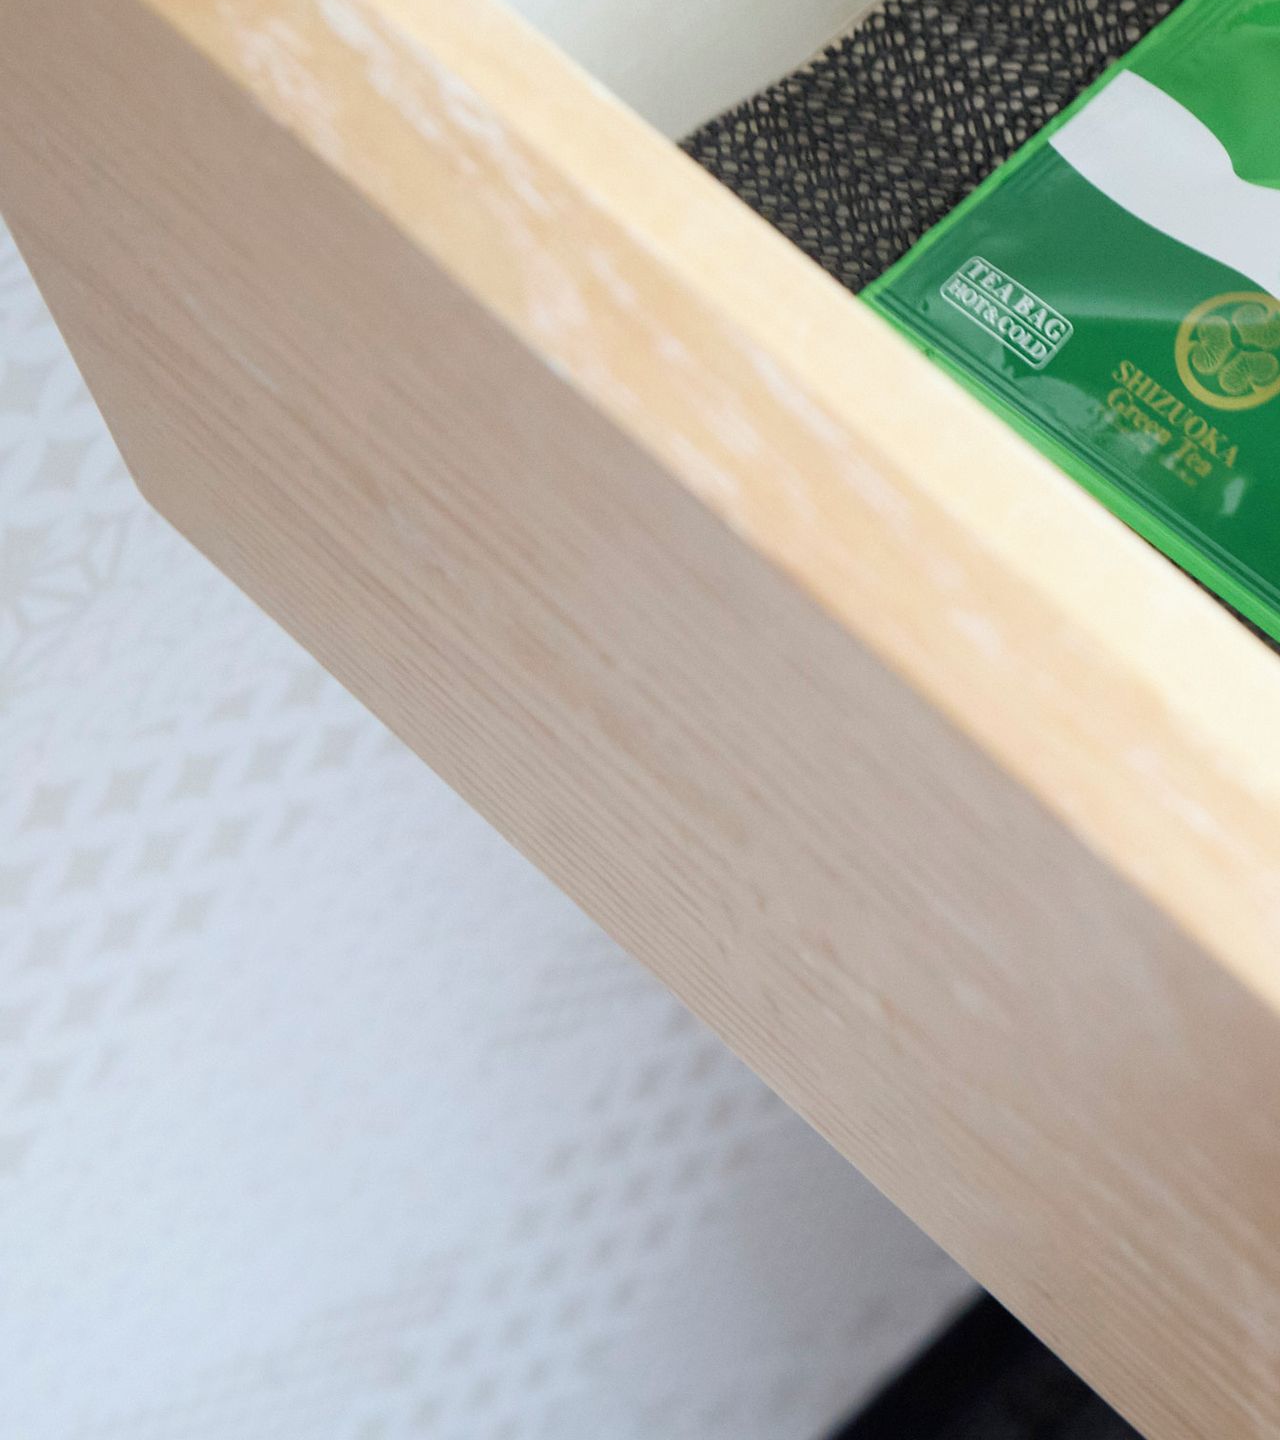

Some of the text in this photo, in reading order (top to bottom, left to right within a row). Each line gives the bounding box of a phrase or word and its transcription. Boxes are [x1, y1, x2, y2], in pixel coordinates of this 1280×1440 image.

[946, 277, 1048, 360] HOT&COLD
[967, 259, 1067, 341] TEA BAG
[1107, 387, 1172, 445] Green
[1173, 436, 1213, 478] Tea
[1111, 359, 1238, 469] SHIZUOKA
